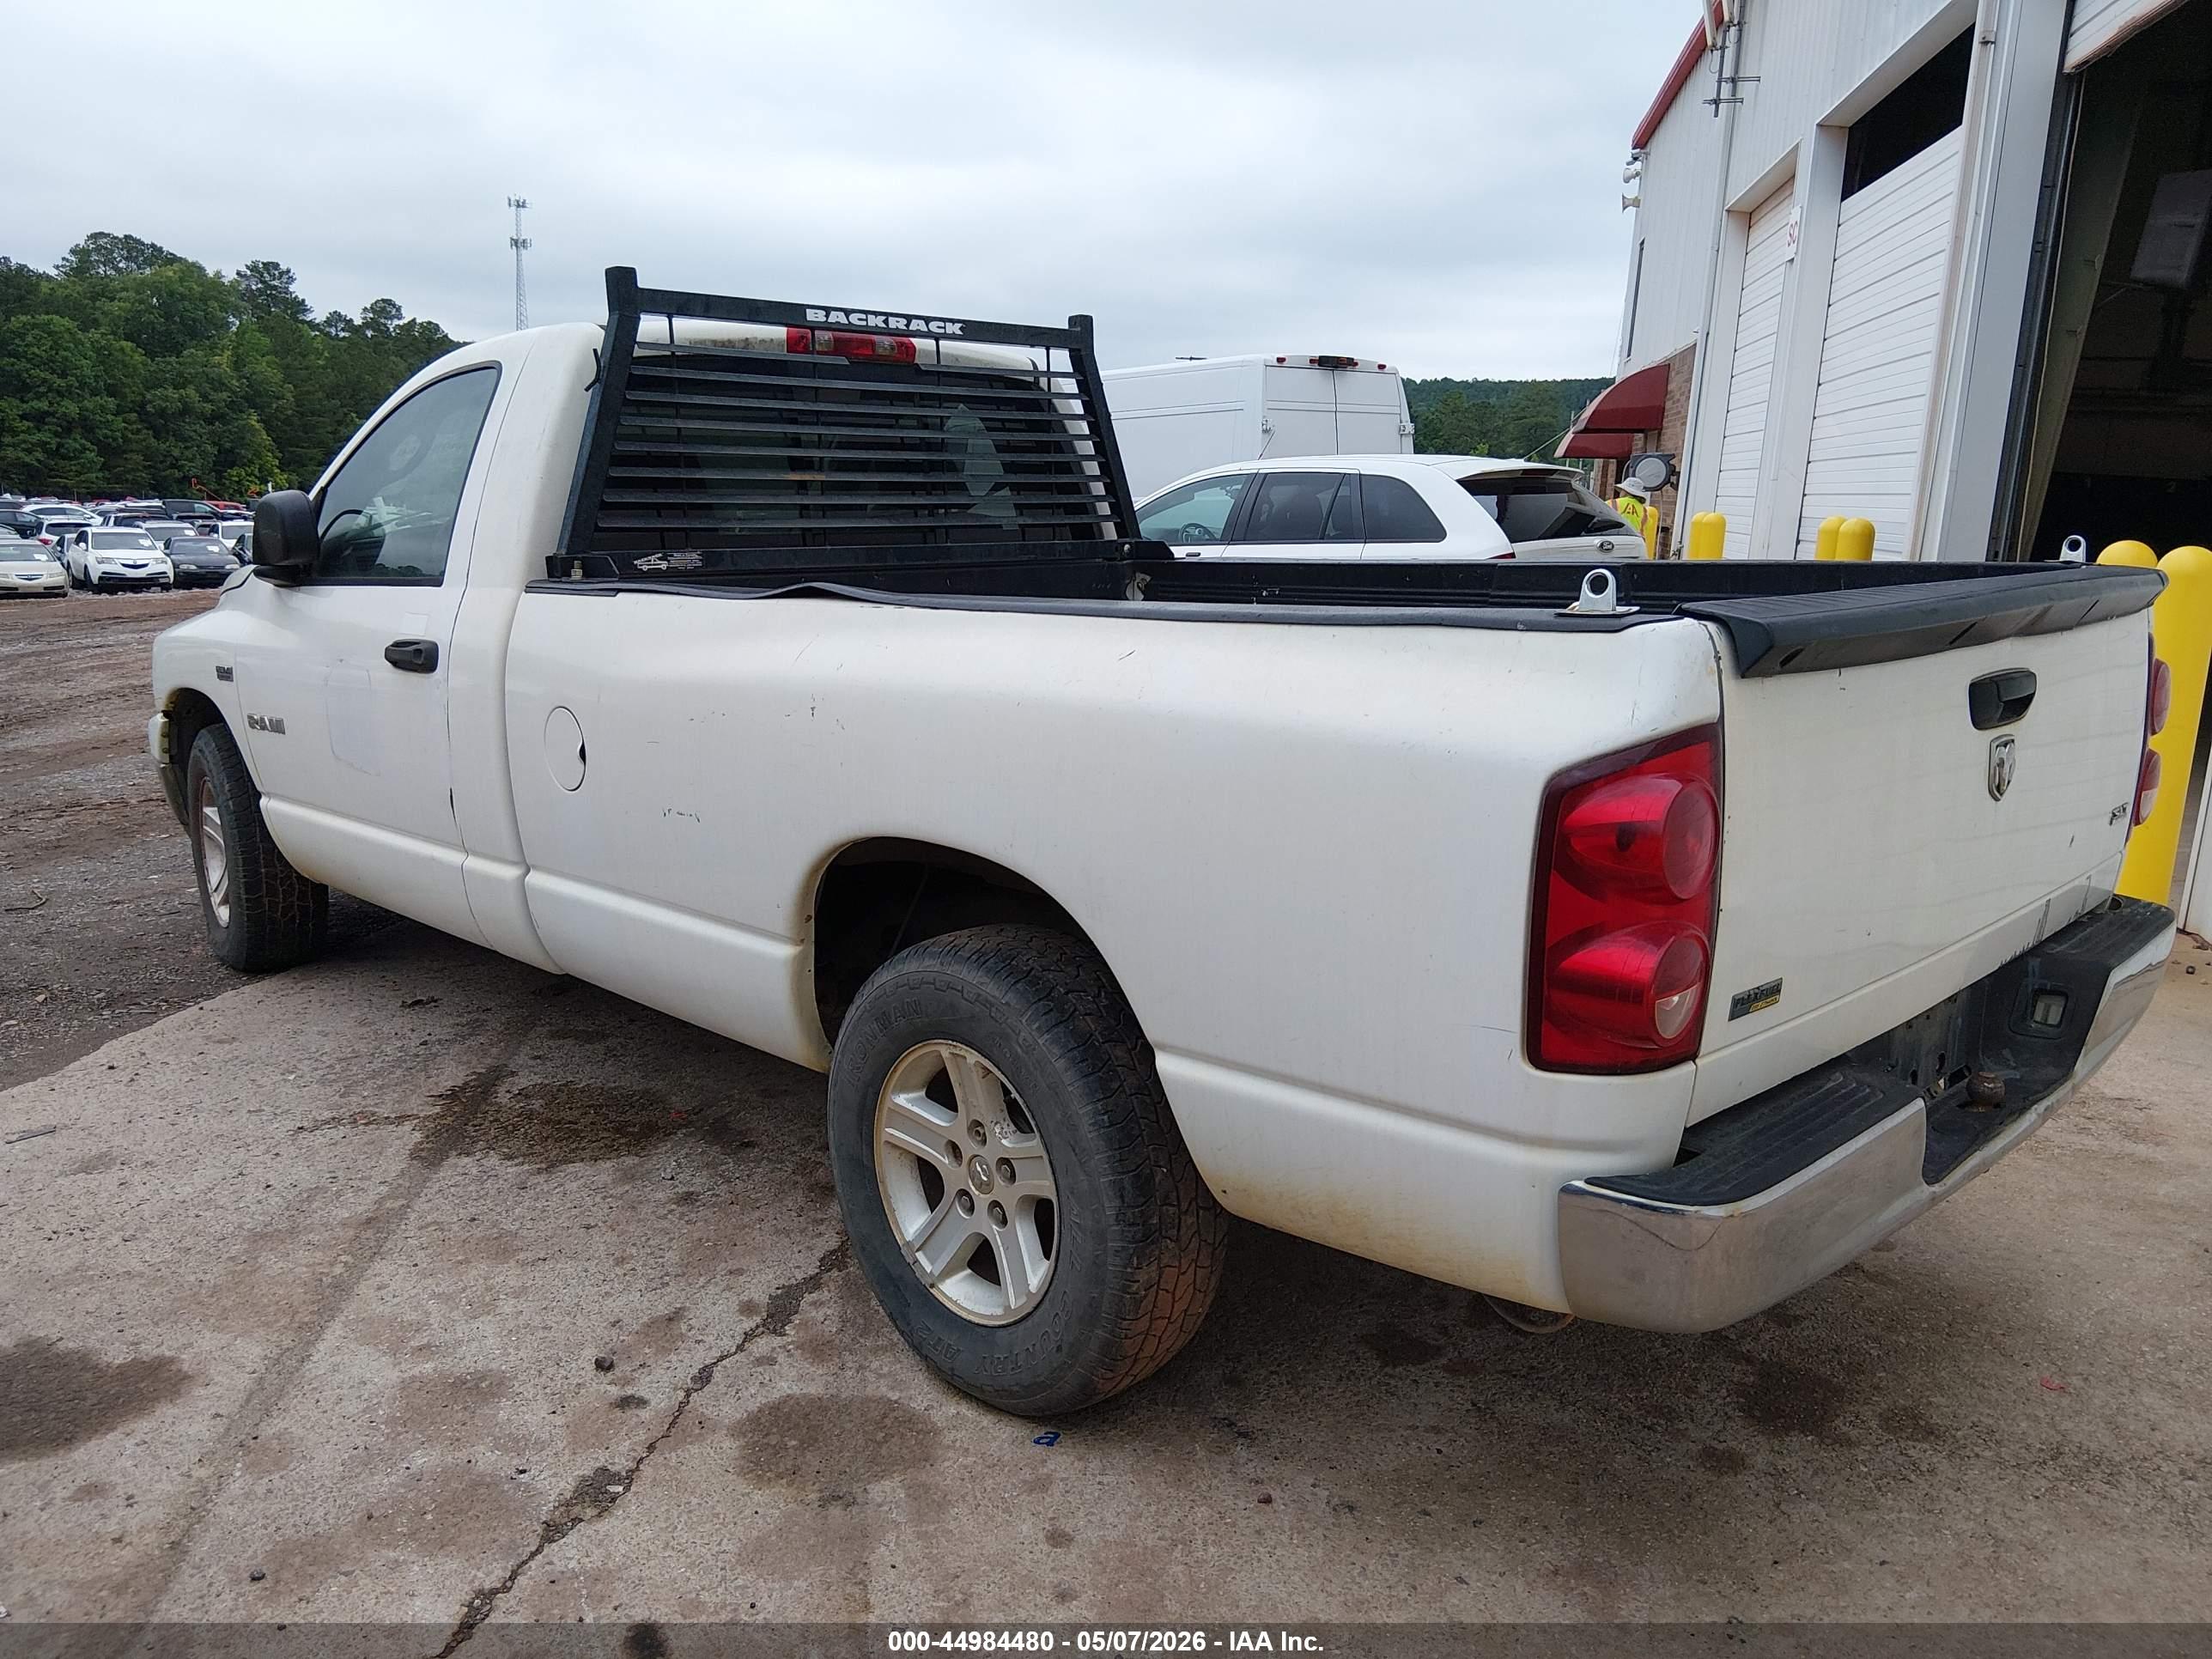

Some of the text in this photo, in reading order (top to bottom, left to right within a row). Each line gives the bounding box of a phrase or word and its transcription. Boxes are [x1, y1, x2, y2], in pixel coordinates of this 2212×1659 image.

[805, 308, 963, 335] BACKRACK
[246, 713, 286, 735] RAM
[842, 996, 922, 1087] IRONMAN
[973, 1289, 1074, 1377] COUNTRY
